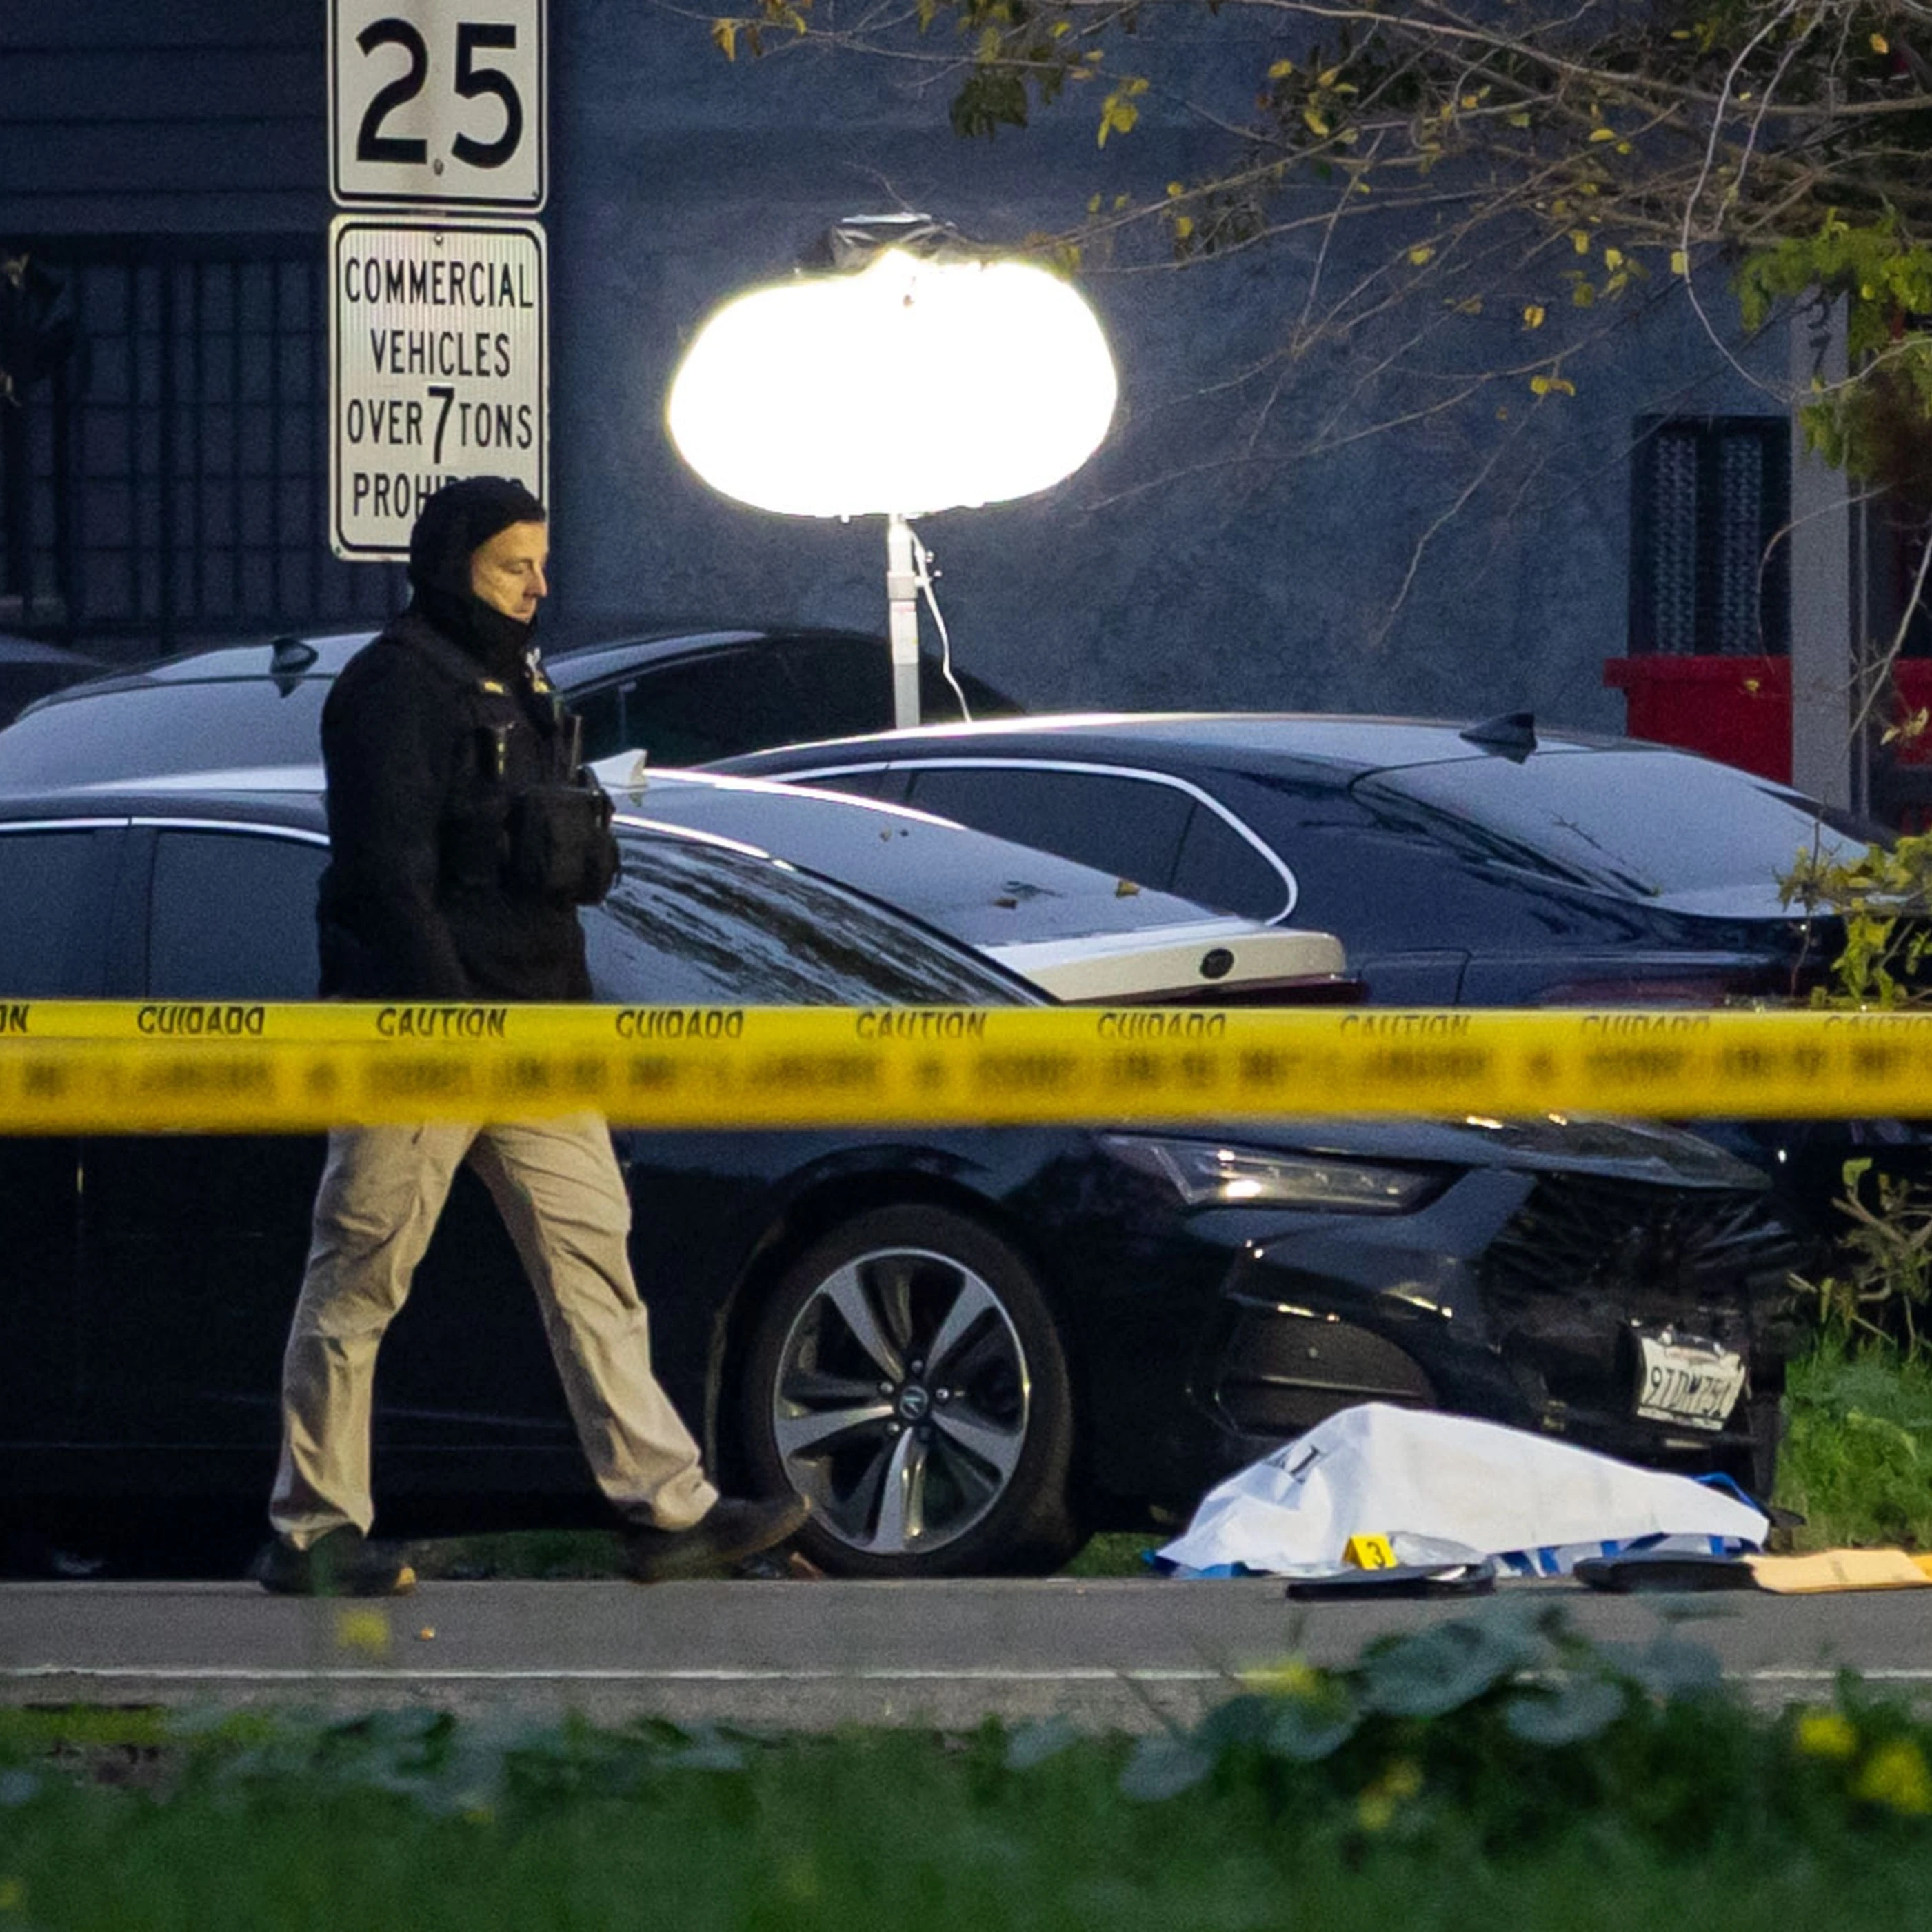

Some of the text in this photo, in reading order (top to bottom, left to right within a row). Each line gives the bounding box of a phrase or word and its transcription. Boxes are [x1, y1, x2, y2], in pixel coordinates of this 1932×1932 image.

[355, 17, 523, 170] 25
[345, 257, 534, 308] COMMERCIAL
[370, 328, 511, 378] VEHICLES
[347, 386, 533, 464] OVER 7 TONS
[138, 1006, 265, 1035] CUIDADO
[376, 1007, 509, 1038] CAUTION
[615, 1009, 744, 1039] CUIDADO
[856, 1011, 988, 1040] CAUTION
[1097, 1012, 1227, 1039] CUIDADO
[1366, 1540, 1386, 1569] 3
